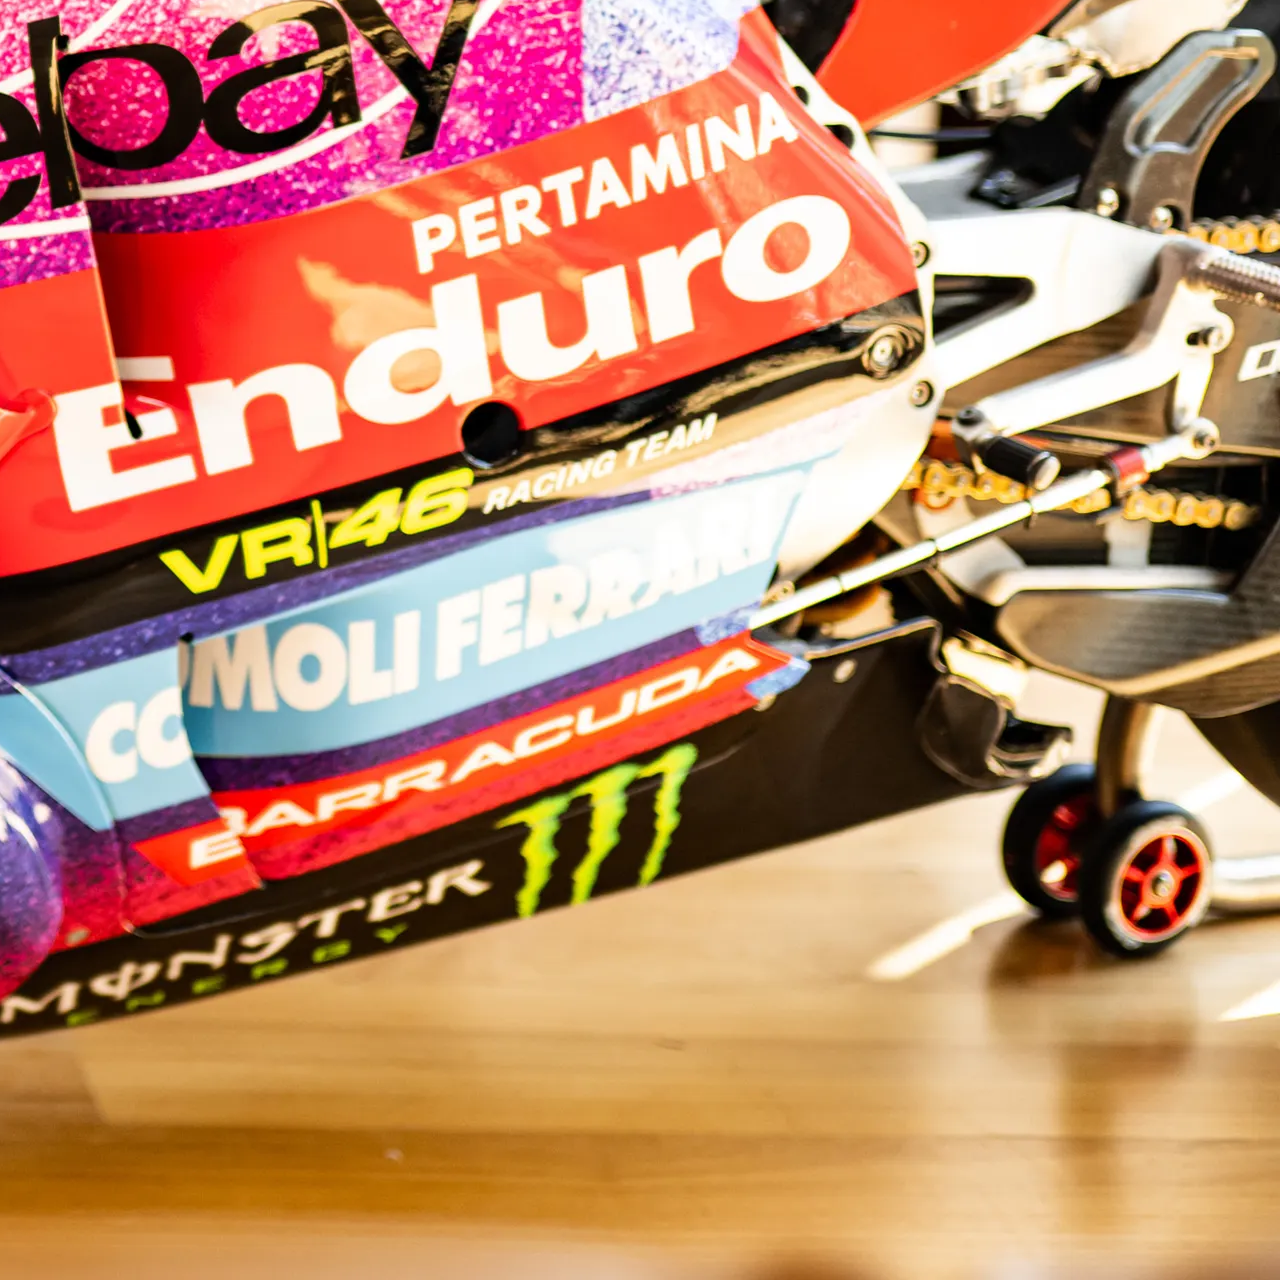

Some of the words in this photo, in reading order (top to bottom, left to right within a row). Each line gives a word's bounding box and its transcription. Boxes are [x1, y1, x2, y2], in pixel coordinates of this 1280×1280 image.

[410, 89, 800, 276] PERTAMINA
[51, 193, 852, 514] Enduro
[482, 449, 617, 515] RACING
[624, 412, 719, 469] TEAM
[188, 644, 762, 871] BARRACUDA
